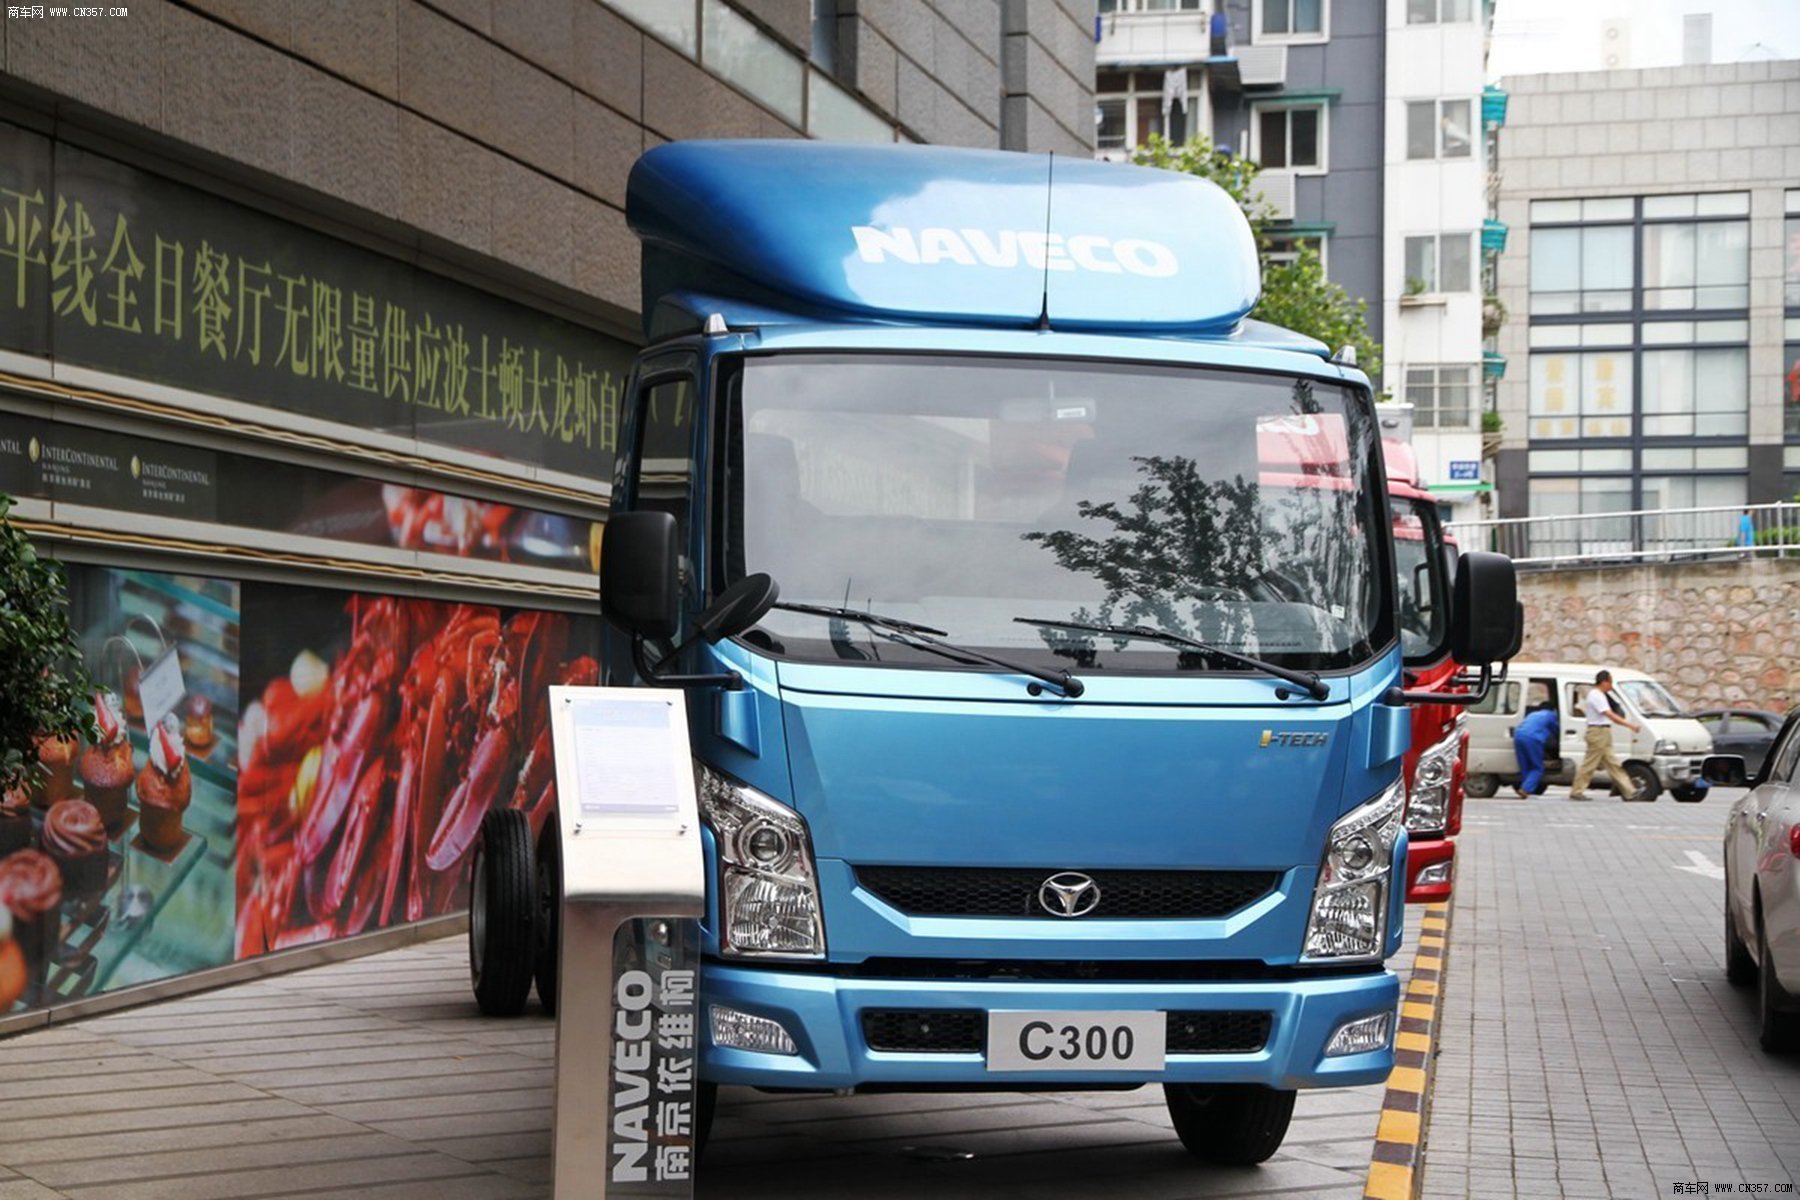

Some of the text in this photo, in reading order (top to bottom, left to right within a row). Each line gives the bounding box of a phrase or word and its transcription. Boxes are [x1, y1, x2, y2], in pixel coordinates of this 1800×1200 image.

[0, 188, 626, 454] 平线全日餐厅无限量供应波士顿大龙虾自
[851, 226, 1179, 277] NAVECO
[612, 970, 652, 1182] NAVECO
[655, 970, 694, 1181] 南京依维柯
[1019, 1021, 1134, 1060] C300
